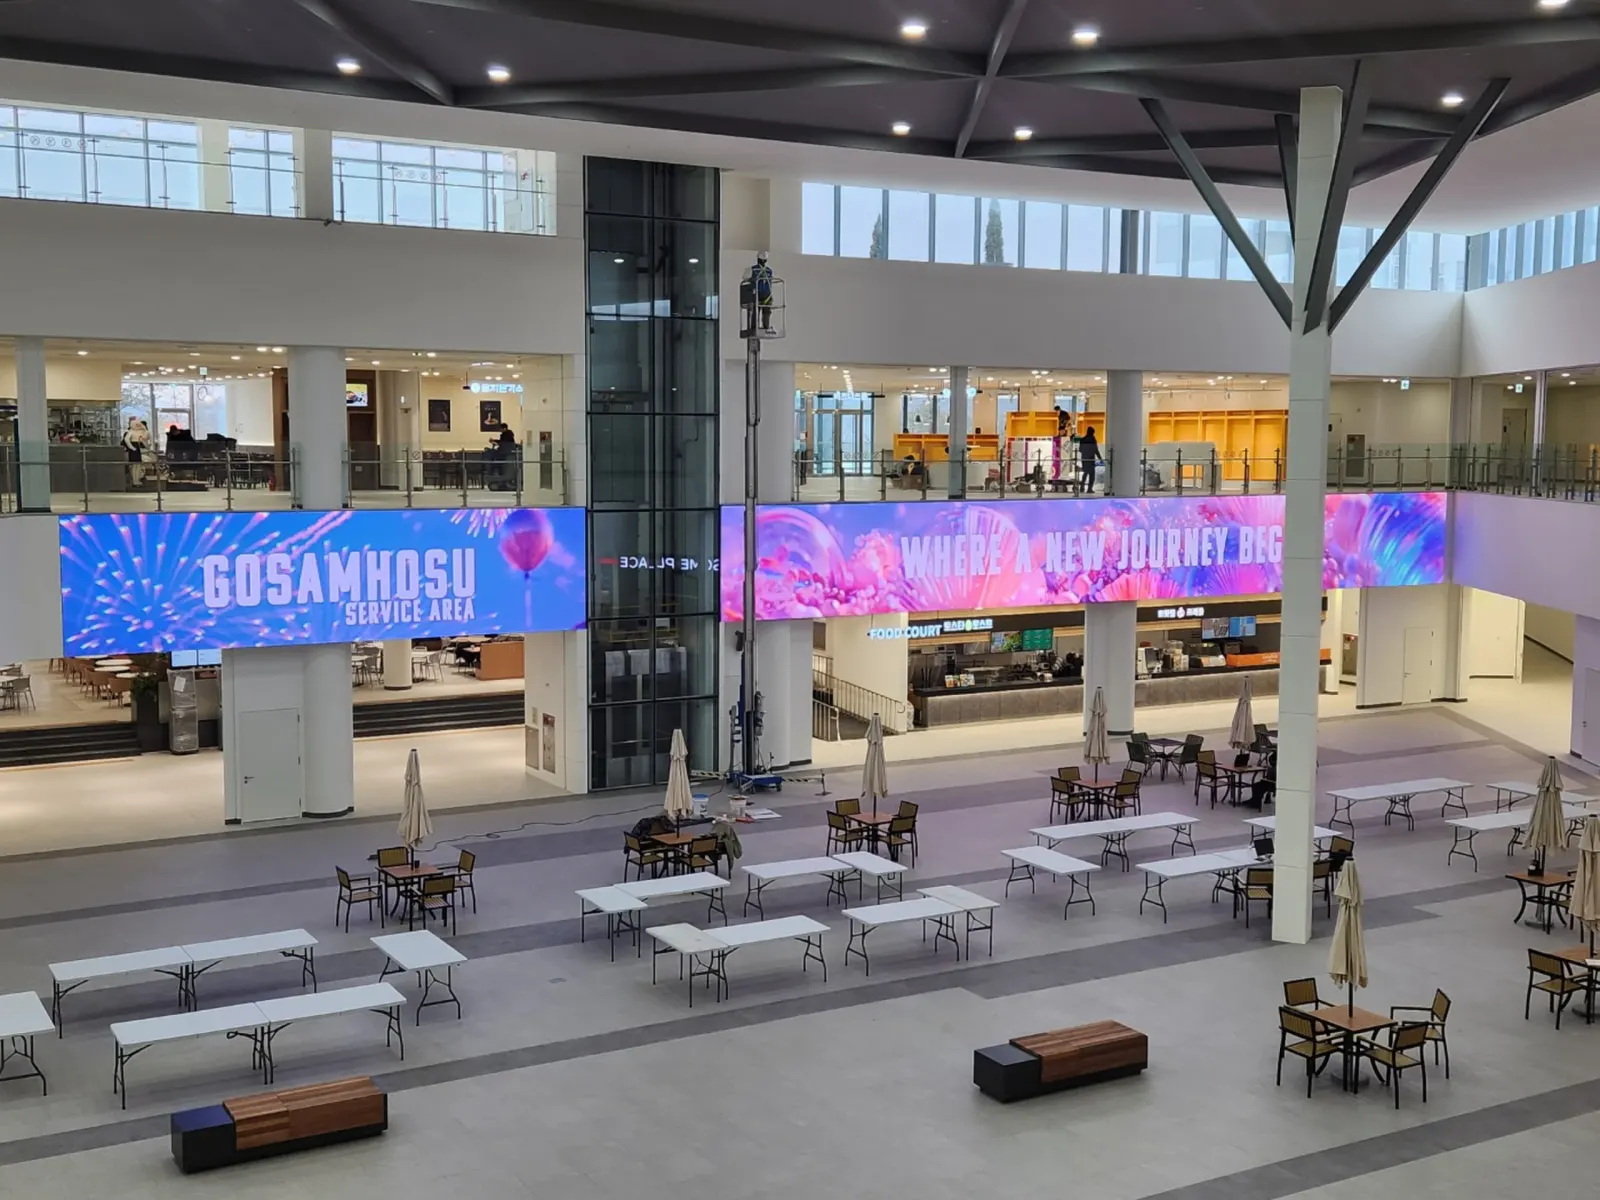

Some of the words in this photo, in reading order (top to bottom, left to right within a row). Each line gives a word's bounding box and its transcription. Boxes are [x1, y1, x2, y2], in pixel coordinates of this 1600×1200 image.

[901, 533, 1001, 580] WHERE
[1014, 532, 1032, 574] A
[1046, 530, 1106, 574] NEW
[1117, 526, 1229, 570] JOURNEY
[1239, 524, 1283, 565] BEG
[203, 548, 476, 608] GOSAMHOSU
[345, 599, 422, 626] SERVICE
[428, 597, 475, 622] AREA
[869, 627, 902, 641] FOOD
[904, 624, 943, 639] COURT
